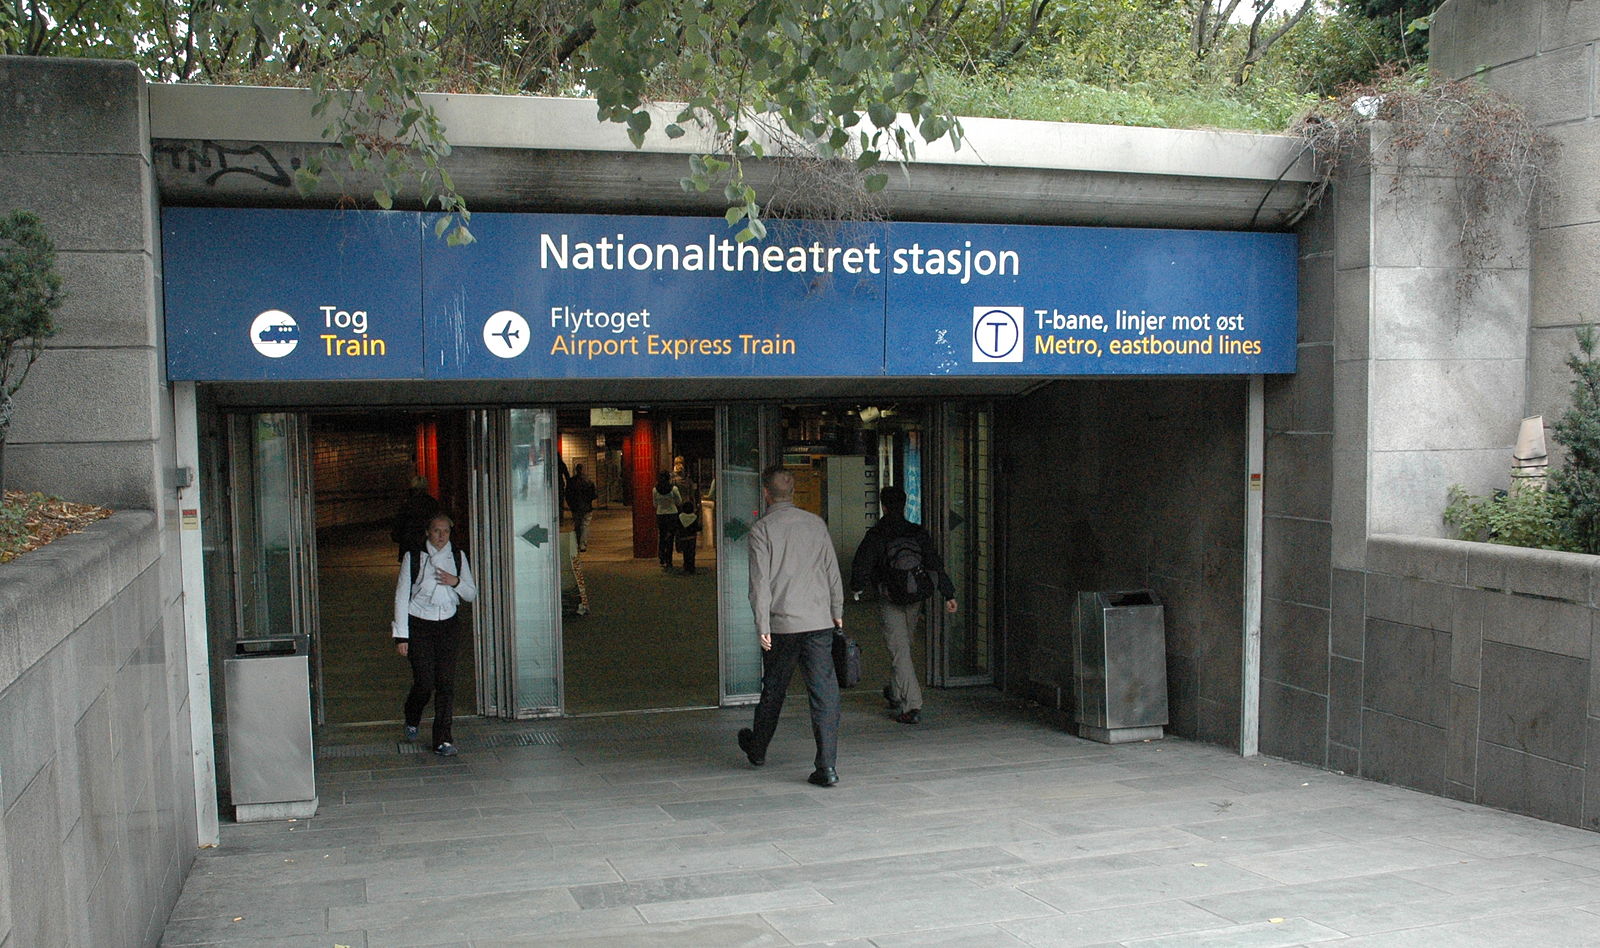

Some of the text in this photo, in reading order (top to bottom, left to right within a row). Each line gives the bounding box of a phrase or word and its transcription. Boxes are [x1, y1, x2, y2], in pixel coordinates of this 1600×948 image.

[540, 233, 1020, 283] Nationaltheatret stasjon
[320, 306, 368, 332] Tog
[551, 306, 650, 333] Flytoget
[1035, 309, 1245, 335] T-bane, linjer mot øst
[320, 333, 386, 356] Train
[551, 334, 796, 361] Airport Express Train
[1035, 333, 1262, 358] Metro, eastbound lines
[864, 470, 877, 530] BILLE
